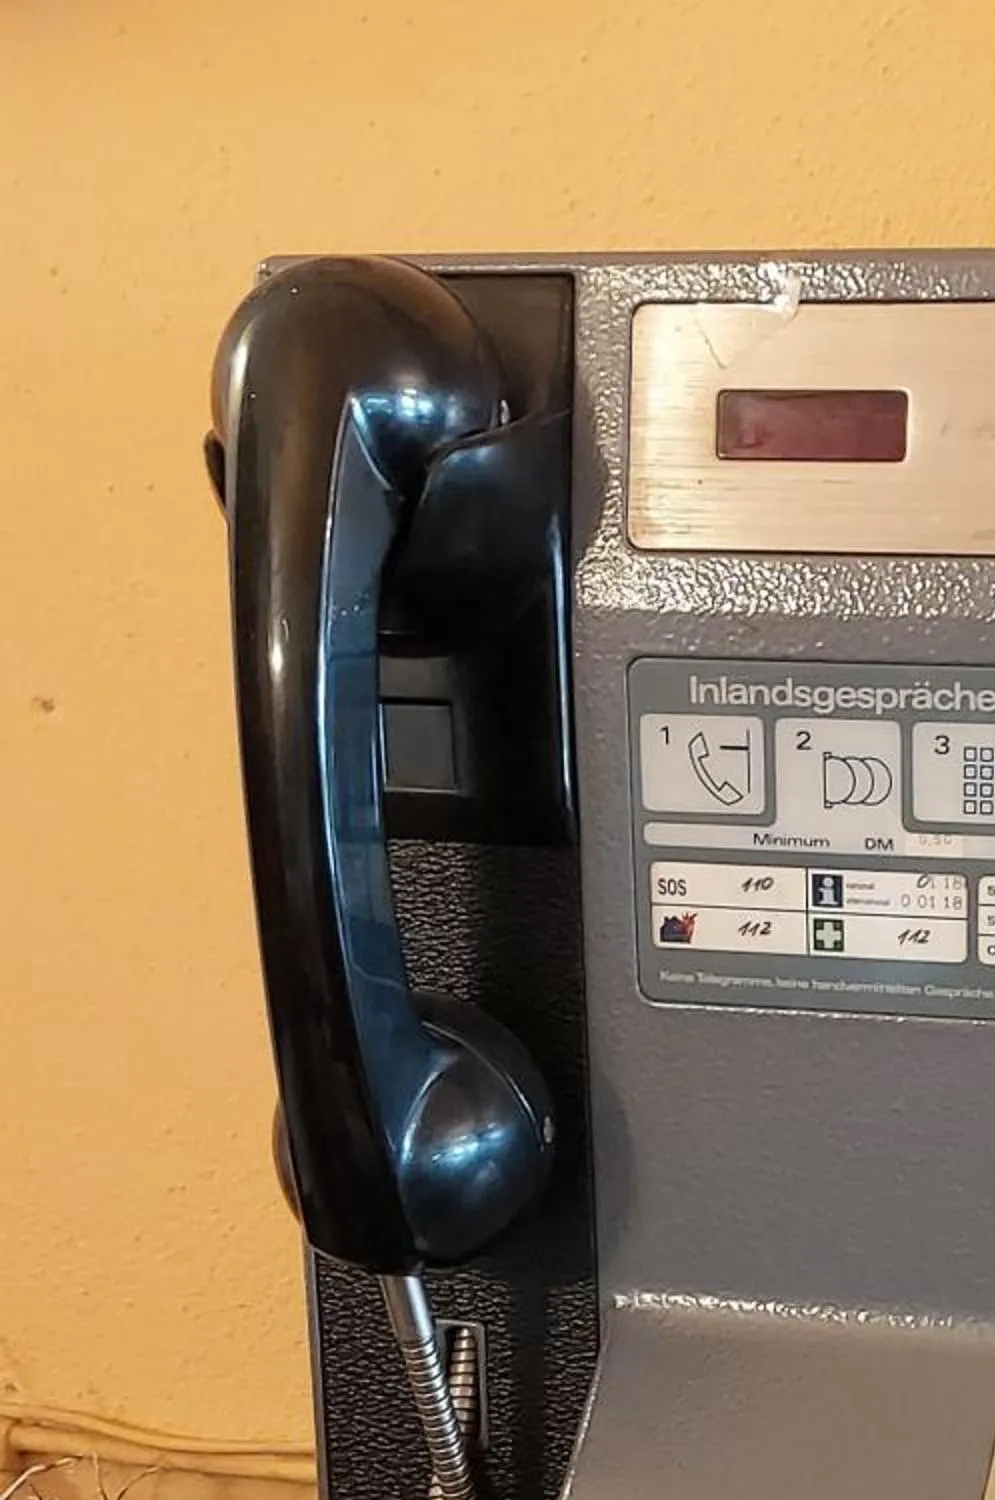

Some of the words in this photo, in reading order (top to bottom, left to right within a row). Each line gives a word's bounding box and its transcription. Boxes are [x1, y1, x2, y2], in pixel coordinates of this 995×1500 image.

[660, 726, 670, 746] 1
[796, 730, 812, 751] 2
[933, 735, 951, 756] 3
[752, 832, 831, 849] Minimum
[864, 836, 895, 852] DM
[656, 878, 688, 896] SOS
[740, 876, 775, 893] 110
[737, 920, 773, 937] 112
[897, 928, 931, 945] 112
